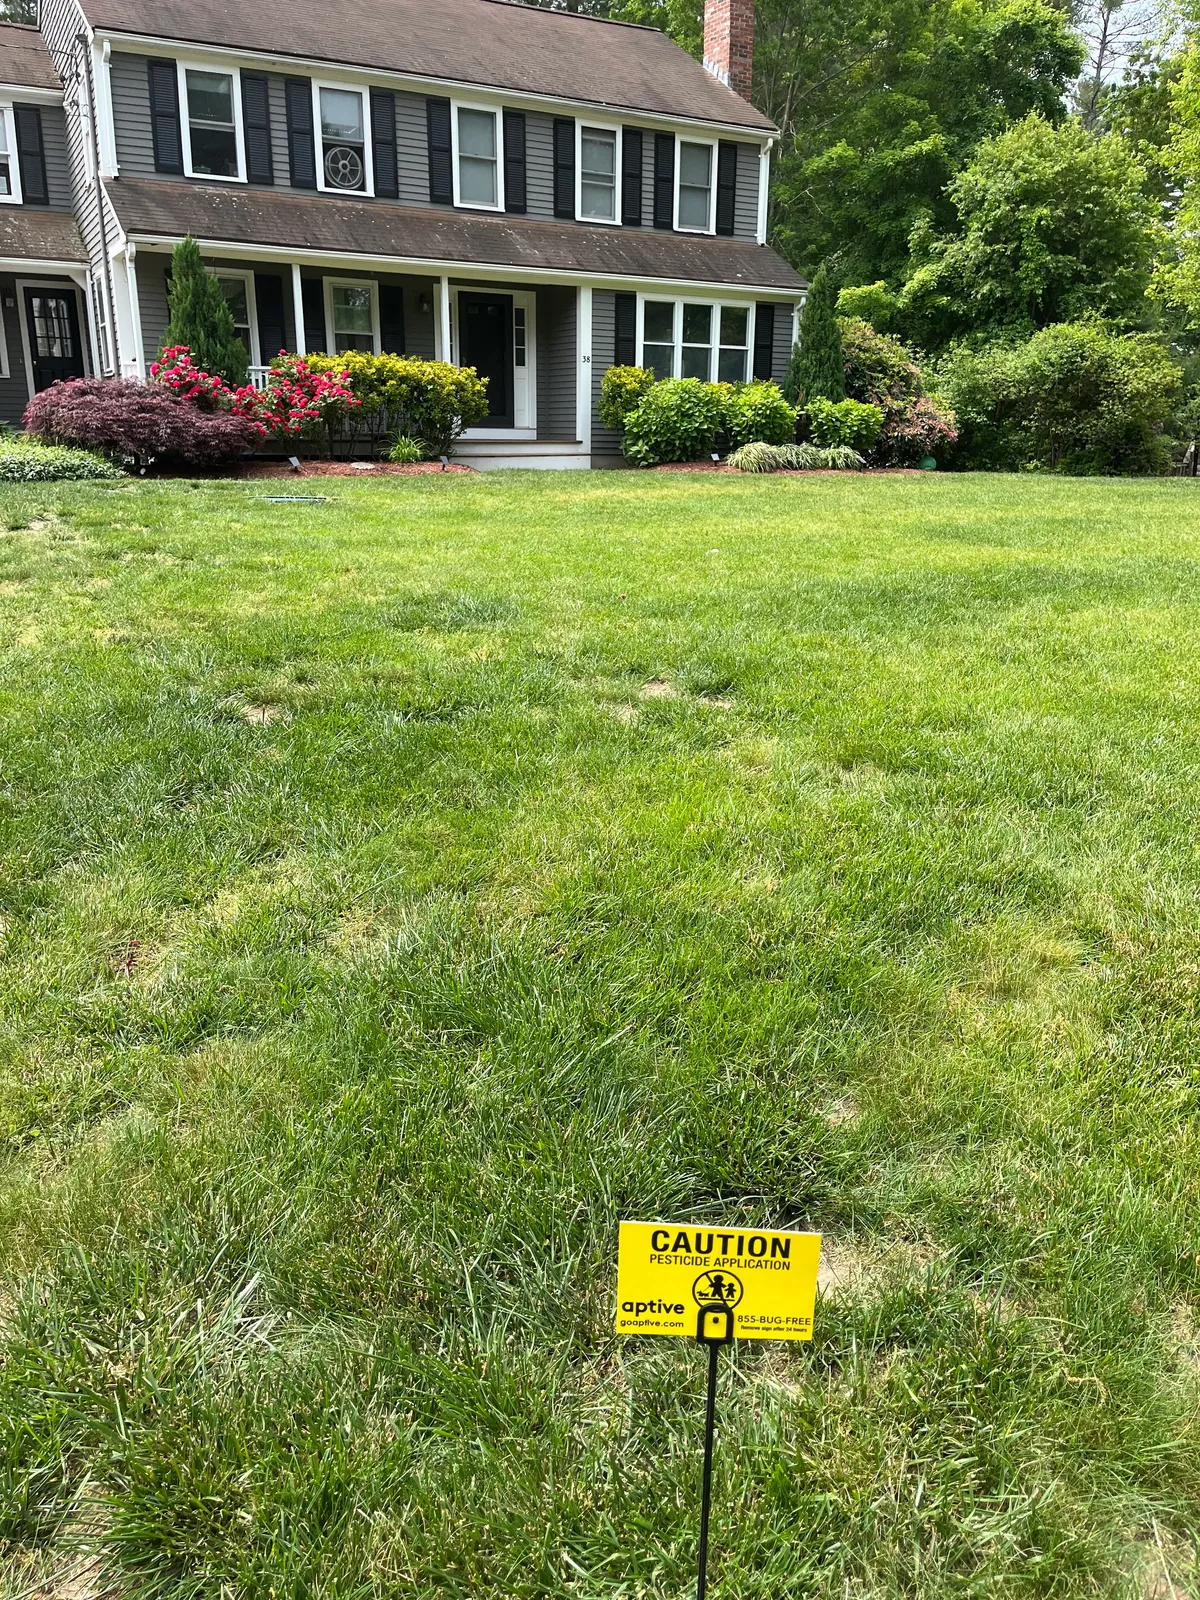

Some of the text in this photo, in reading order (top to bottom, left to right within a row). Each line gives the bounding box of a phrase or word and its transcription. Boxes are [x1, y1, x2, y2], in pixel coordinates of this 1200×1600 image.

[582, 355, 591, 363] 38
[651, 1230, 791, 1258] CAUTION
[649, 1254, 791, 1271] PESTICIDE APPLICATION
[621, 1298, 685, 1317] aptive
[620, 1319, 684, 1328] goaptive.com
[737, 1315, 811, 1325] 855-BUG-FREE
